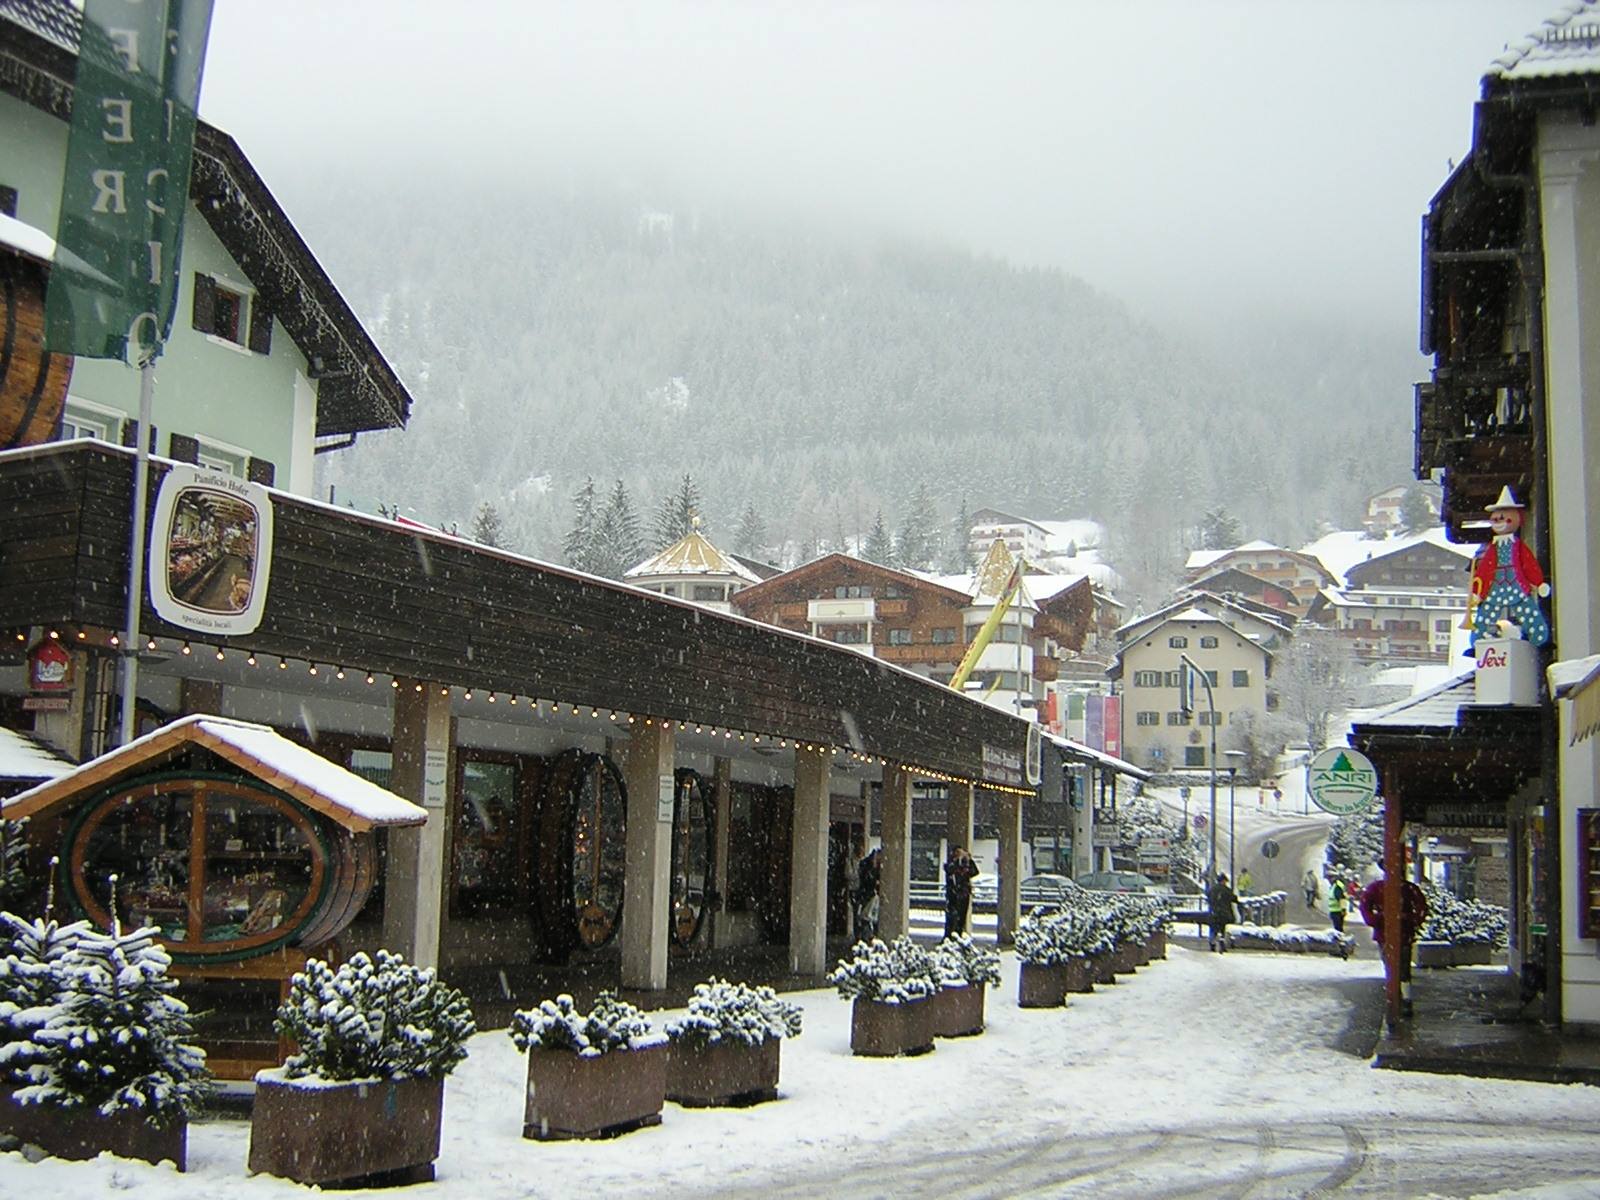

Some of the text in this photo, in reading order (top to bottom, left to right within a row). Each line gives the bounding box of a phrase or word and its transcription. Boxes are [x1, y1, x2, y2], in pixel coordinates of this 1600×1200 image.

[194, 473, 249, 497] Panificio Hofer
[1314, 772, 1372, 784] ANRI
